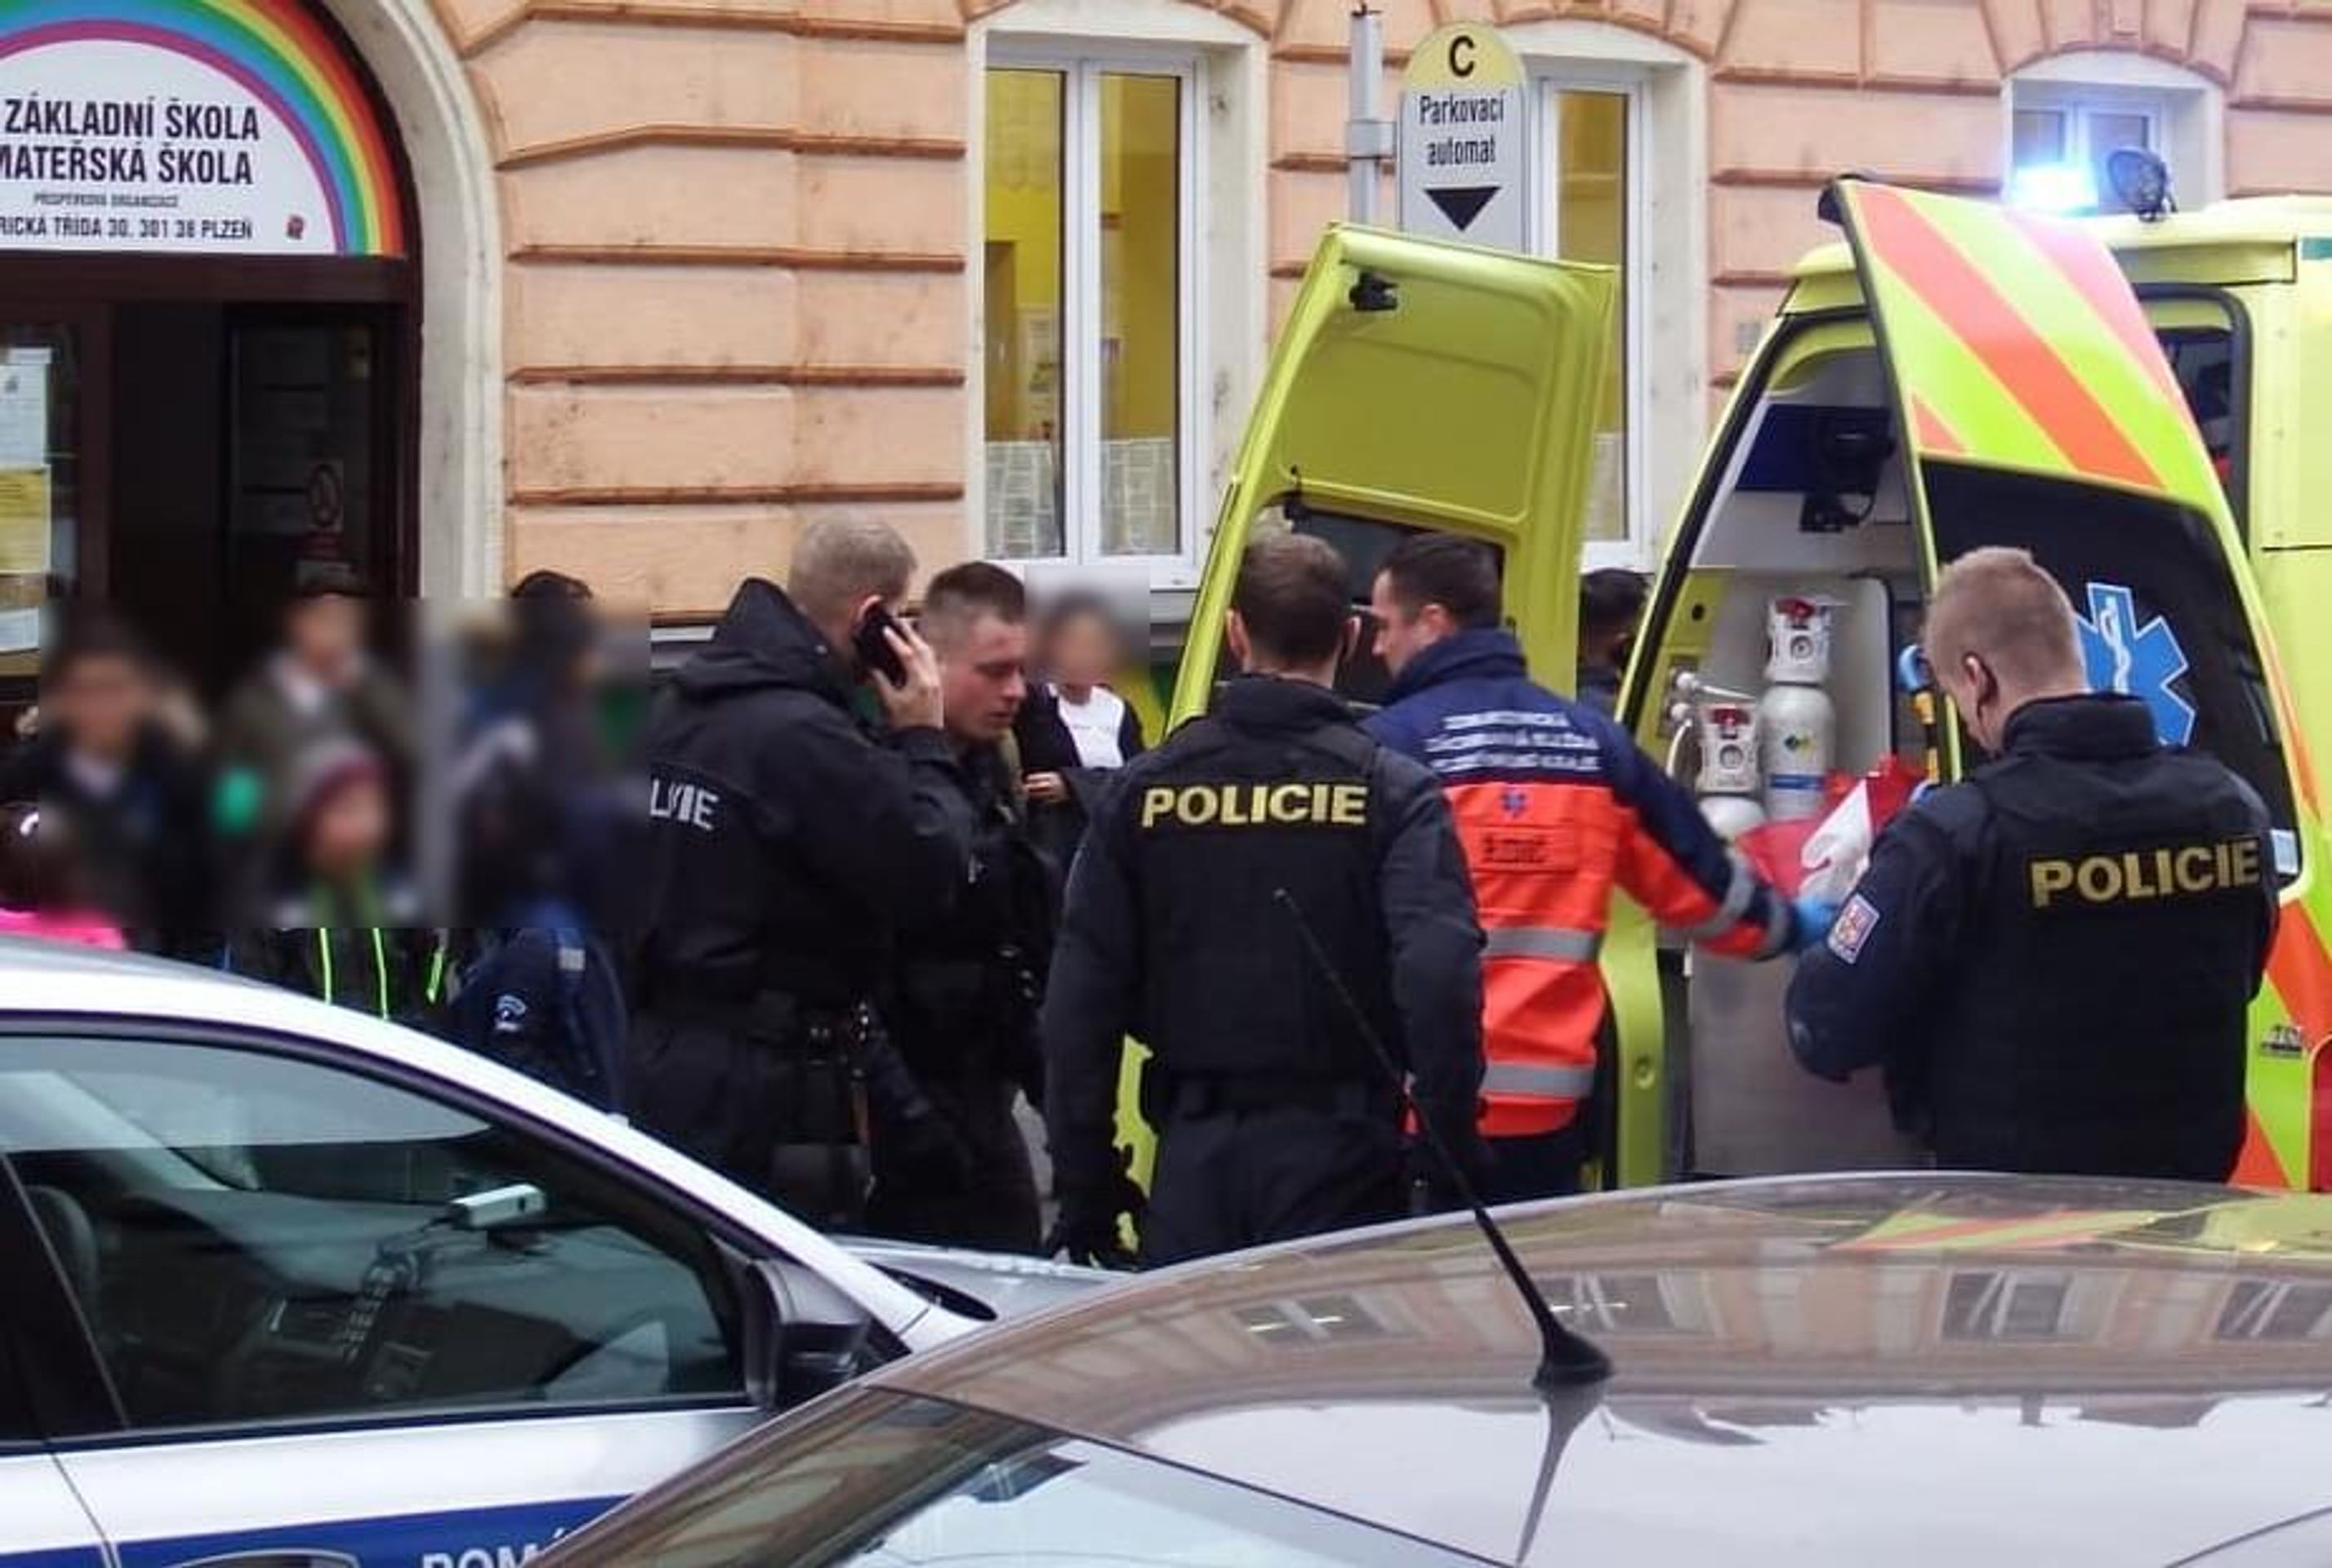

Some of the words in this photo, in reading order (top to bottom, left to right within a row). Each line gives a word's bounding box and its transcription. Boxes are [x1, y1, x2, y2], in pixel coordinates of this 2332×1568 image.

[1448, 34, 1475, 77] C
[5, 91, 155, 137] ZÁKLADNÍ
[166, 97, 260, 140] ŠKOLA
[1419, 89, 1505, 125] Parkovací
[158, 142, 252, 185] ŠKOLA
[1428, 136, 1496, 166] automat
[1141, 783, 1368, 828] POLICIE
[2029, 839, 2260, 908] POLICIE
